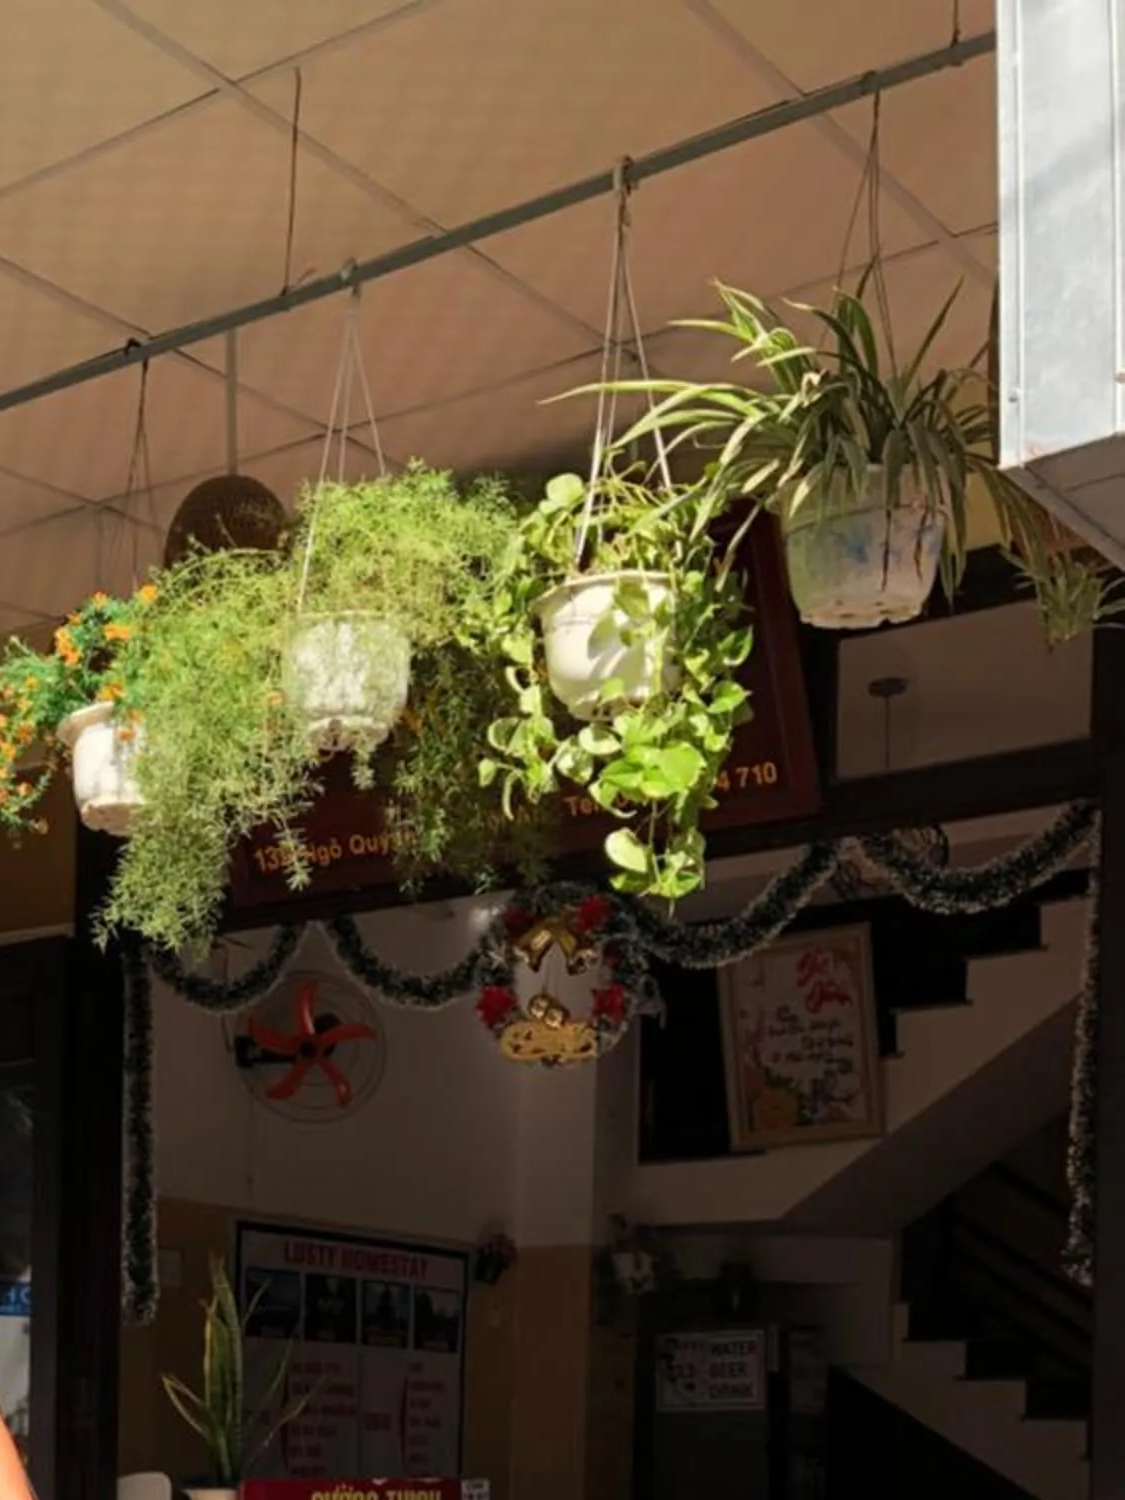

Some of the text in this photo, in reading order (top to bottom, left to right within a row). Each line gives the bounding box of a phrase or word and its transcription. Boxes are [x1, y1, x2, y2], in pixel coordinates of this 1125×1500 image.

[736, 761, 778, 789] 710
[283, 1241, 427, 1279] LUSTY HOMESTAY
